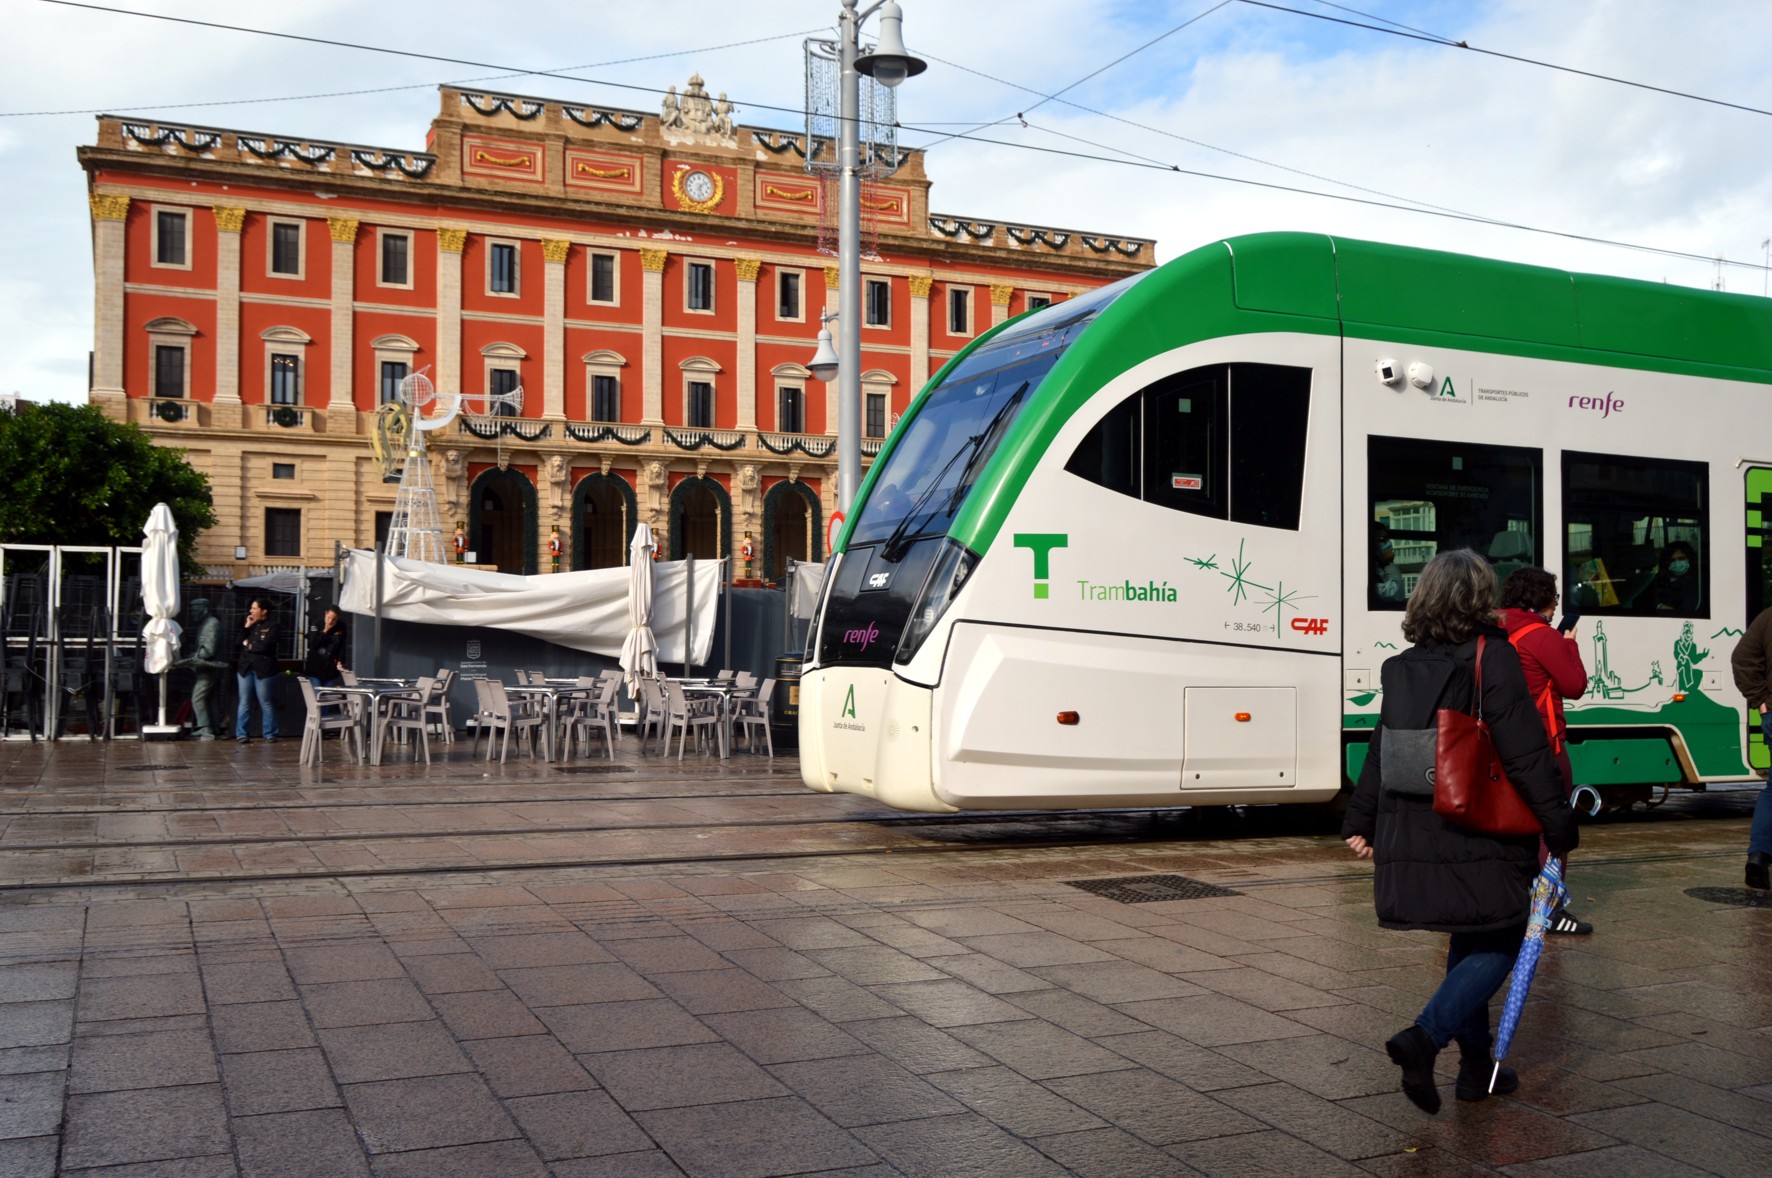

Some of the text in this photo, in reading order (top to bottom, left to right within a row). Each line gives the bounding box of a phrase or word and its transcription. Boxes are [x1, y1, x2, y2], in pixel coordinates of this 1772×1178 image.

[1569, 391, 1625, 419] renfe
[1077, 580, 1178, 602] Trambahía
[843, 620, 879, 652] renfe
[1233, 622, 1261, 632] 38.540
[1291, 617, 1329, 635] CAF
